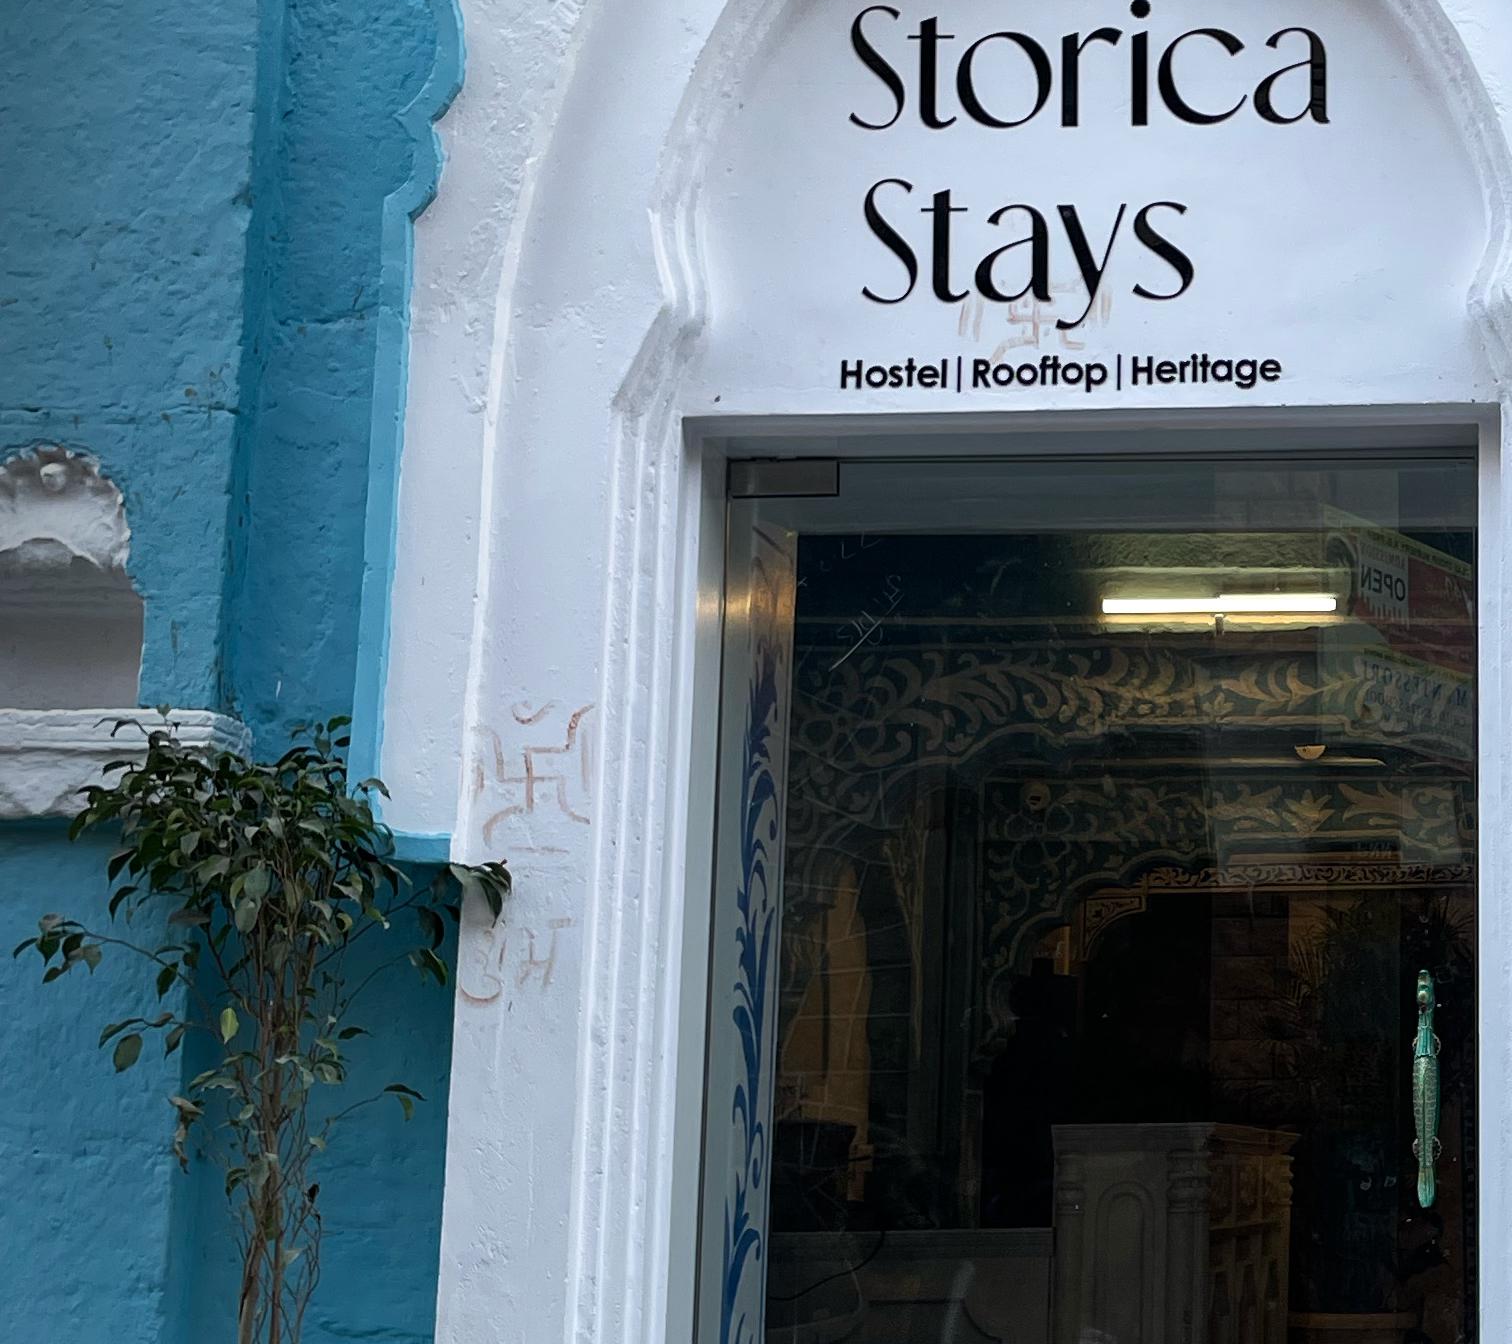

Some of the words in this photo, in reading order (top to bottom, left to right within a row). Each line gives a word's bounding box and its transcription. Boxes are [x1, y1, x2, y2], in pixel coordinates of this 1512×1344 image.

[861, 178, 1195, 331] Stays
[840, 357, 948, 390] Hostel
[972, 355, 1108, 393] Rooftop
[1131, 353, 1282, 390] Heritage
